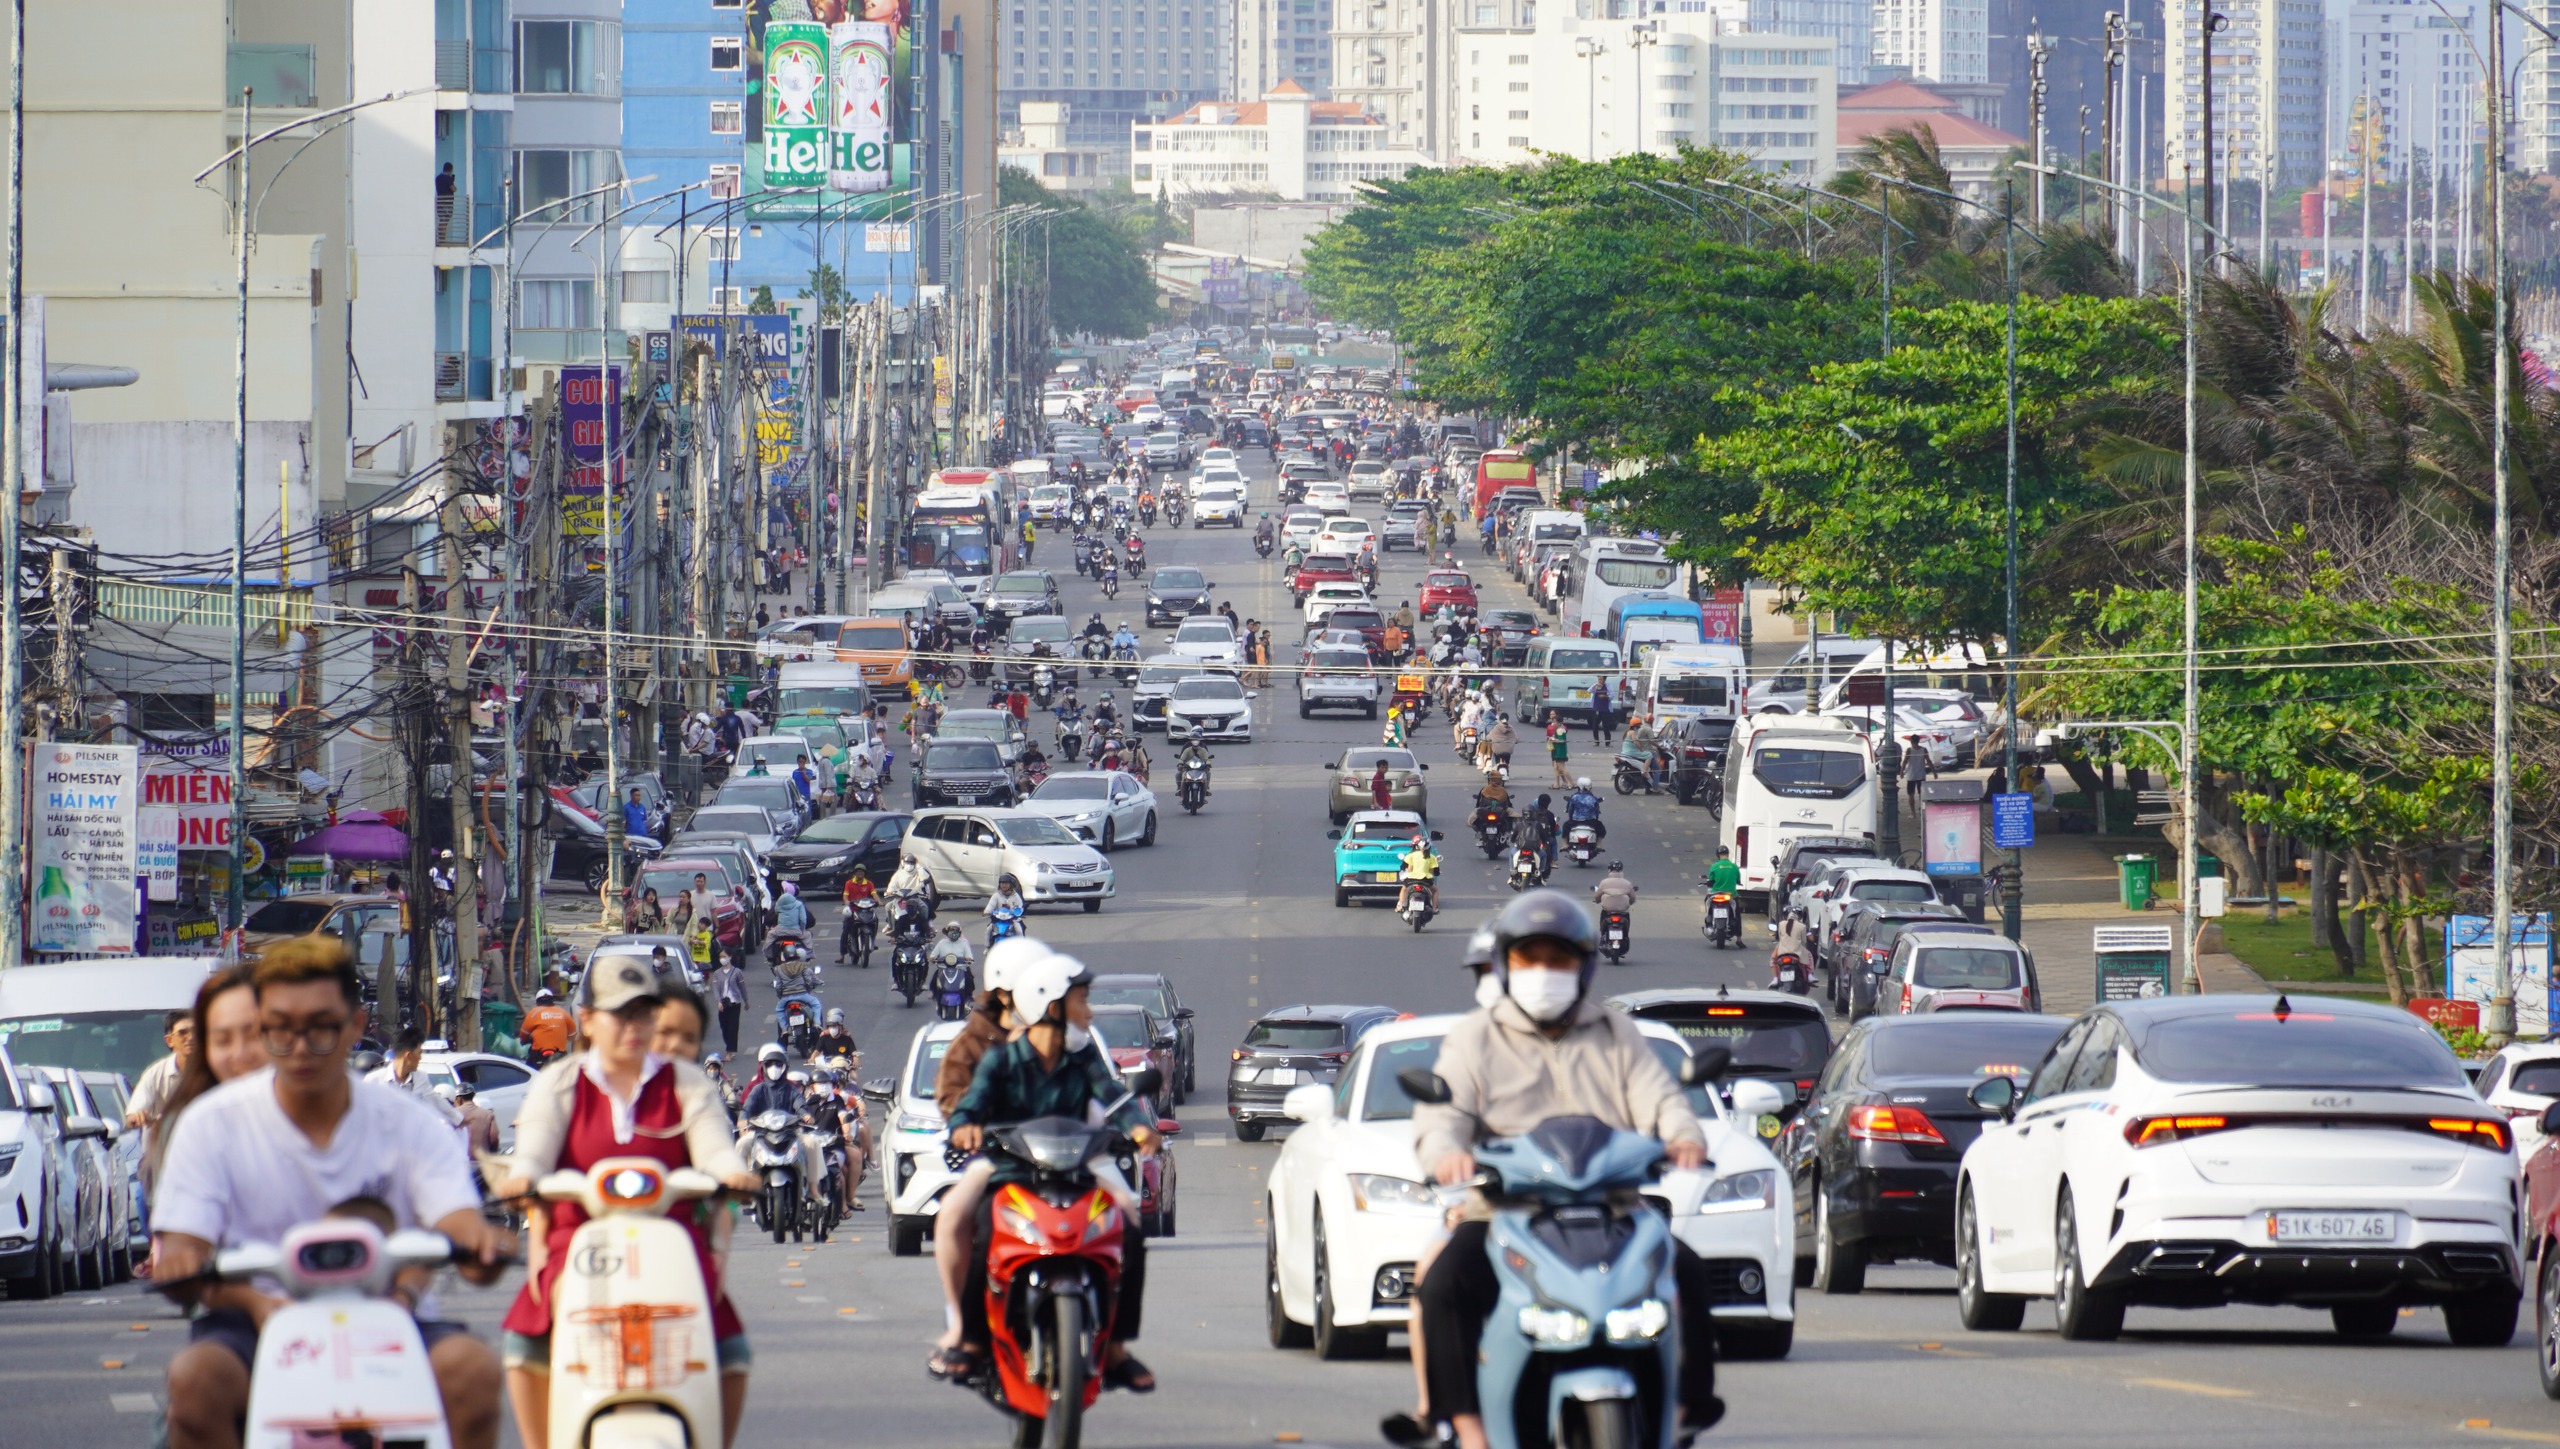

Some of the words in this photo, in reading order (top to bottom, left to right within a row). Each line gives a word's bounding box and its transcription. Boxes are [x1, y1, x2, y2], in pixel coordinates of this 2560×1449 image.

[831, 131, 891, 172] Hei
[680, 315, 715, 327] HÁCH
[650, 336, 667, 348] GS
[650, 348, 667, 360] 25
[75, 752, 119, 761] PILSNER
[47, 772, 122, 786] HOMESTAY
[49, 788, 83, 809] HẢI
[88, 794, 117, 810] MY
[2278, 1217, 2385, 1236] 51K-607.46
